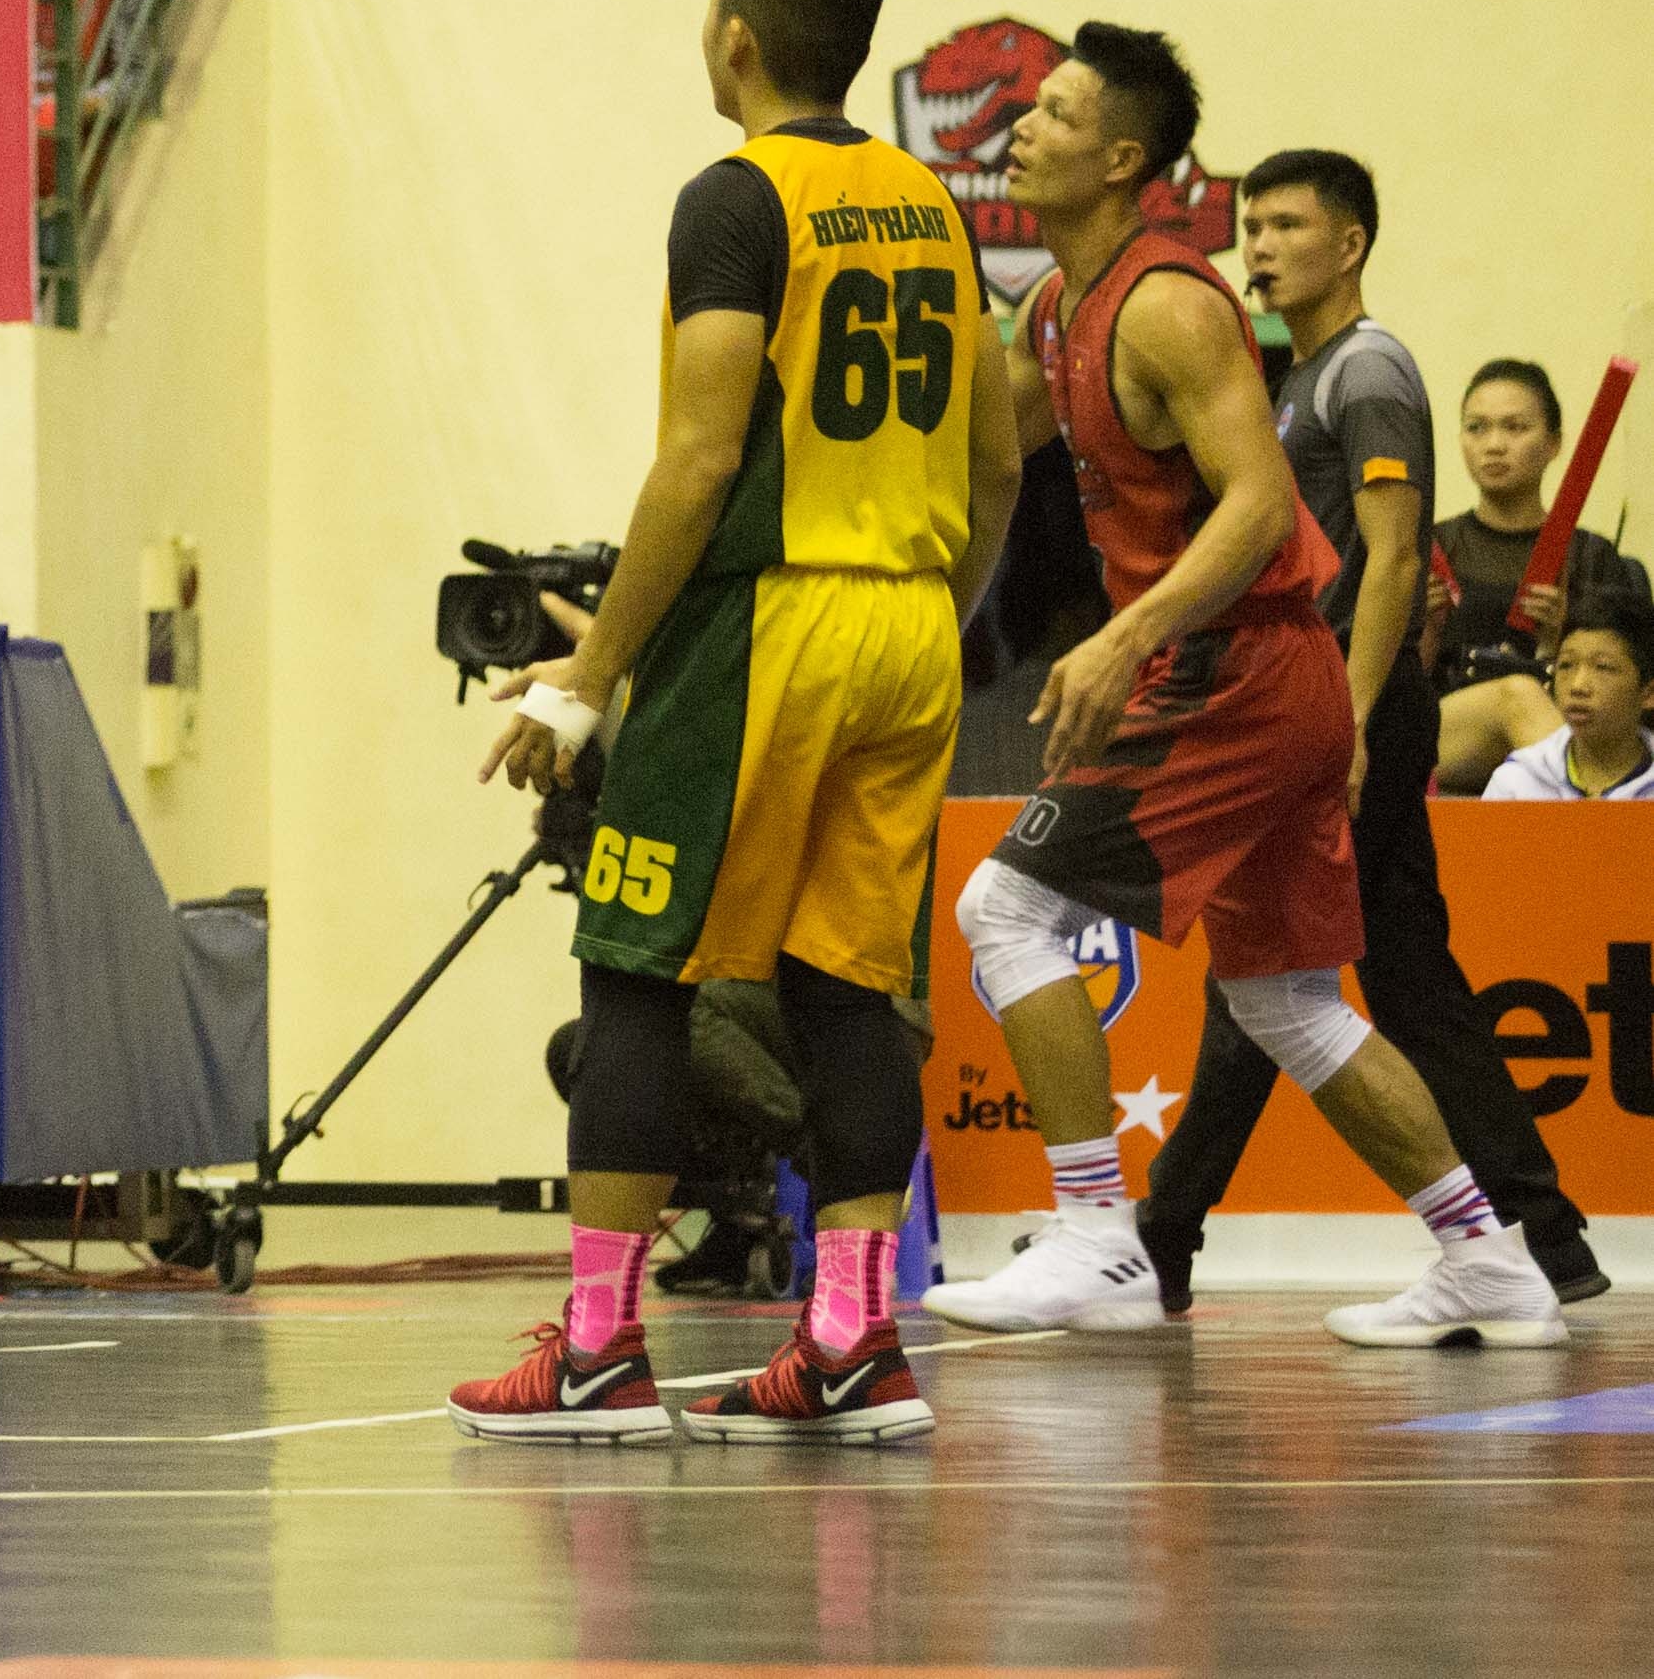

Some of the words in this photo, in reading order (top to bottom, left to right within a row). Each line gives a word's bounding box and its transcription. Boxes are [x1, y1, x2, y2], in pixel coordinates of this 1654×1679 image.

[810, 265, 957, 442] 65
[584, 825, 678, 917] 65
[959, 1064, 989, 1087] By
